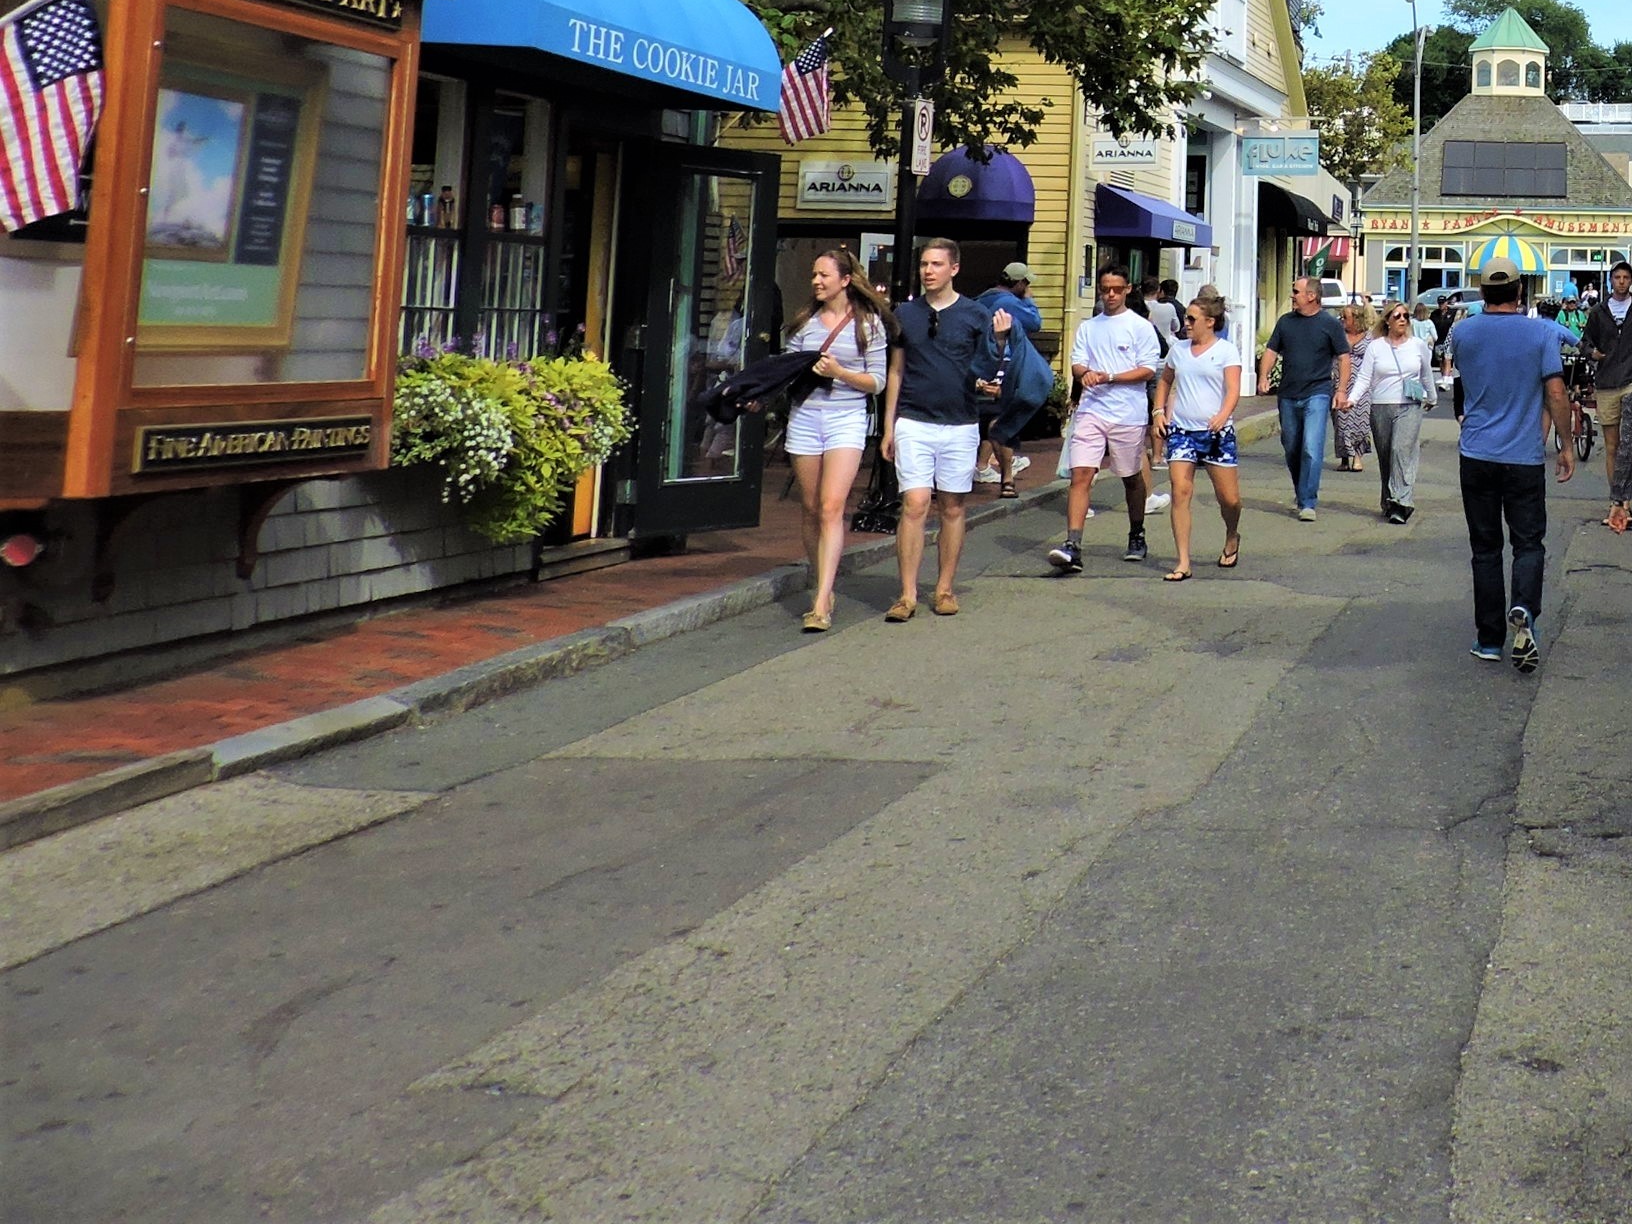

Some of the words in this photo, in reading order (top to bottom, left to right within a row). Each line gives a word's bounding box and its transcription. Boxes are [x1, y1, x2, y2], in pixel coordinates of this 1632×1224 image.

[568, 18, 625, 64] THE
[632, 38, 720, 89] COOKIE
[722, 64, 760, 101] JAR
[1095, 149, 1154, 158] ARIANNA
[807, 182, 883, 194] ARIANNA
[1174, 224, 1195, 237] ARIANNA
[1370, 219, 1409, 230] RYAN
[147, 435, 197, 460] FINE
[197, 430, 289, 457] AMERICAN
[291, 425, 371, 450] PAINTINGS
